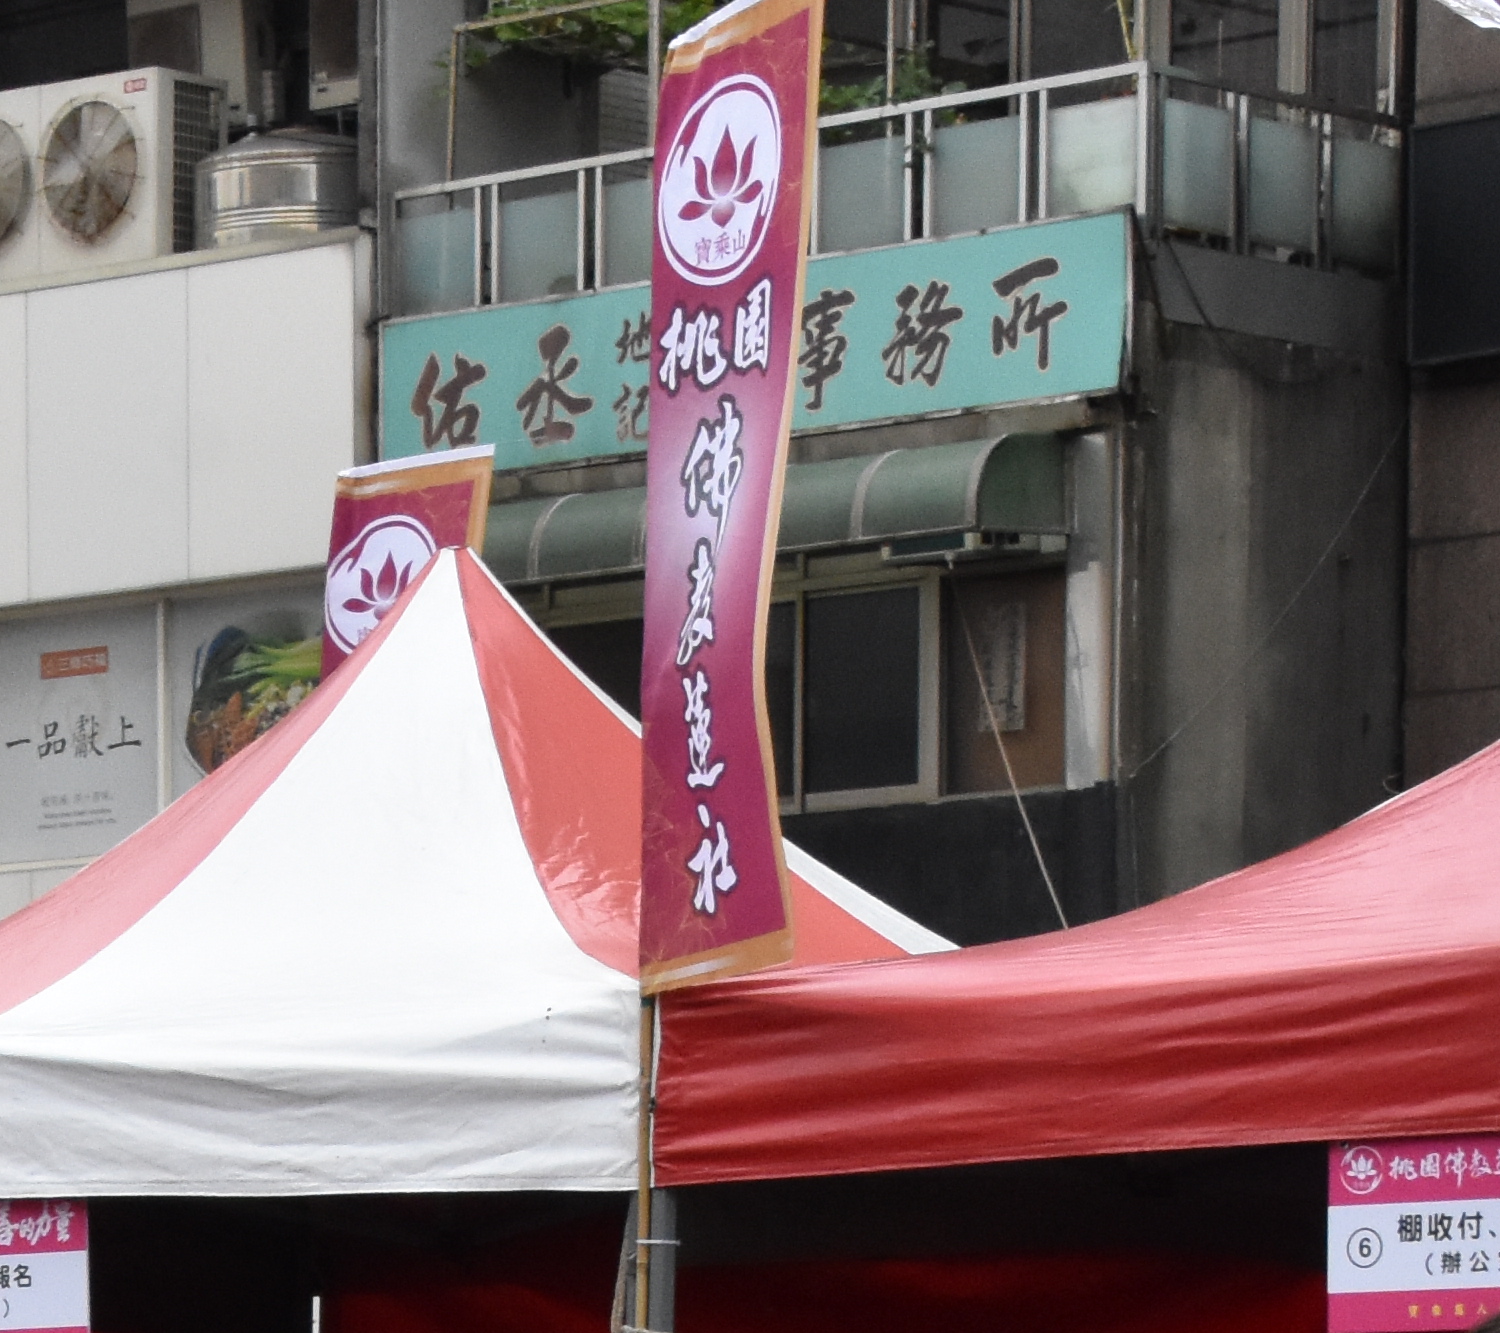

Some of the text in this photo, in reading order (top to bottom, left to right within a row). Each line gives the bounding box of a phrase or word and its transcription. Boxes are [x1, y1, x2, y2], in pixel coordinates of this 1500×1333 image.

[797, 257, 1069, 411] 事務所
[5, 714, 142, 760] 一品獻上
